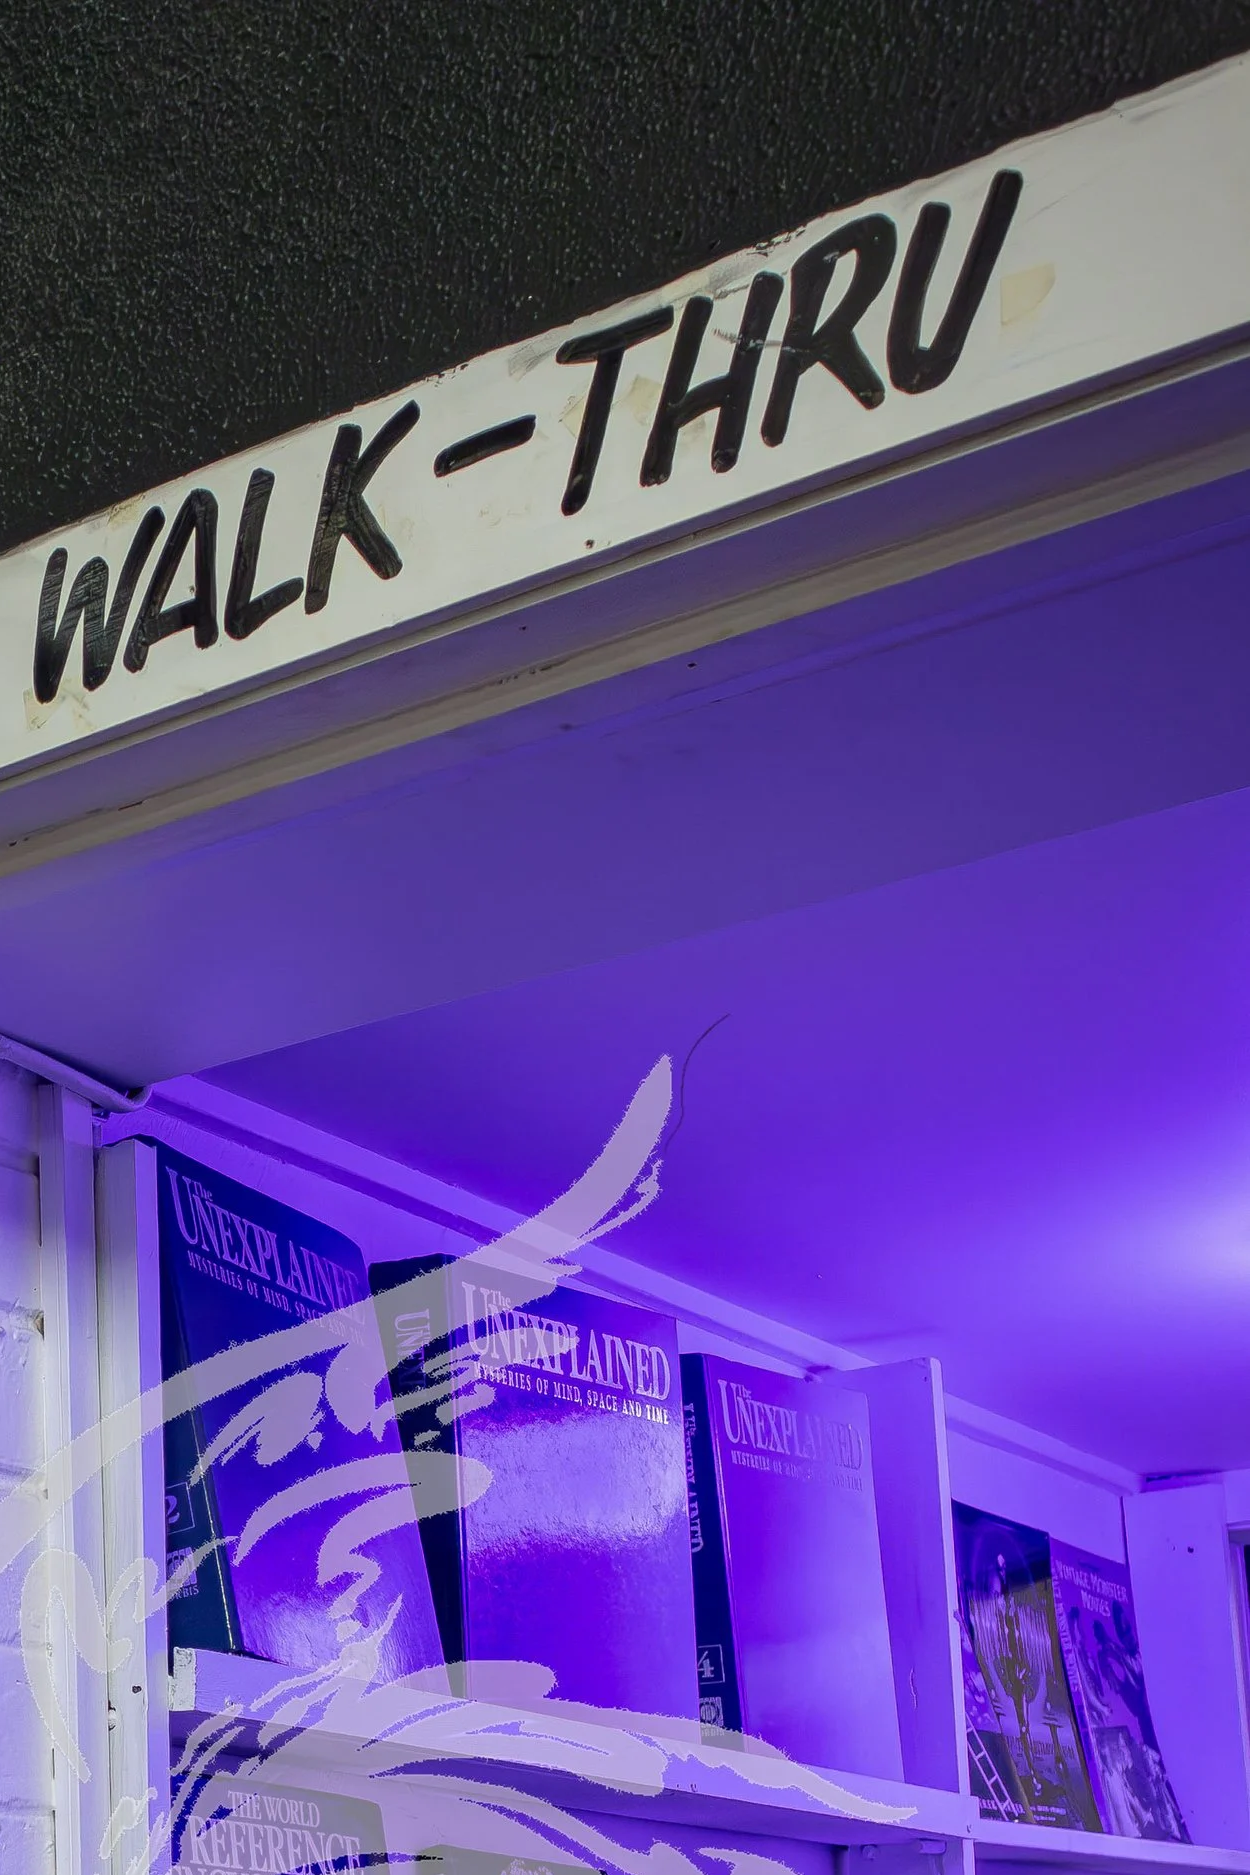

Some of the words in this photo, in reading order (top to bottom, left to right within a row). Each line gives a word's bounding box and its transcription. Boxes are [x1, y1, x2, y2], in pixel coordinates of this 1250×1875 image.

[461, 1282, 672, 1402] UNEXPLAINED
[472, 1362, 530, 1389] MYSTERIES
[534, 1375, 549, 1395] OF
[588, 1390, 618, 1414] SPACE
[622, 1397, 641, 1419] AND
[646, 1403, 671, 1426] TIME
